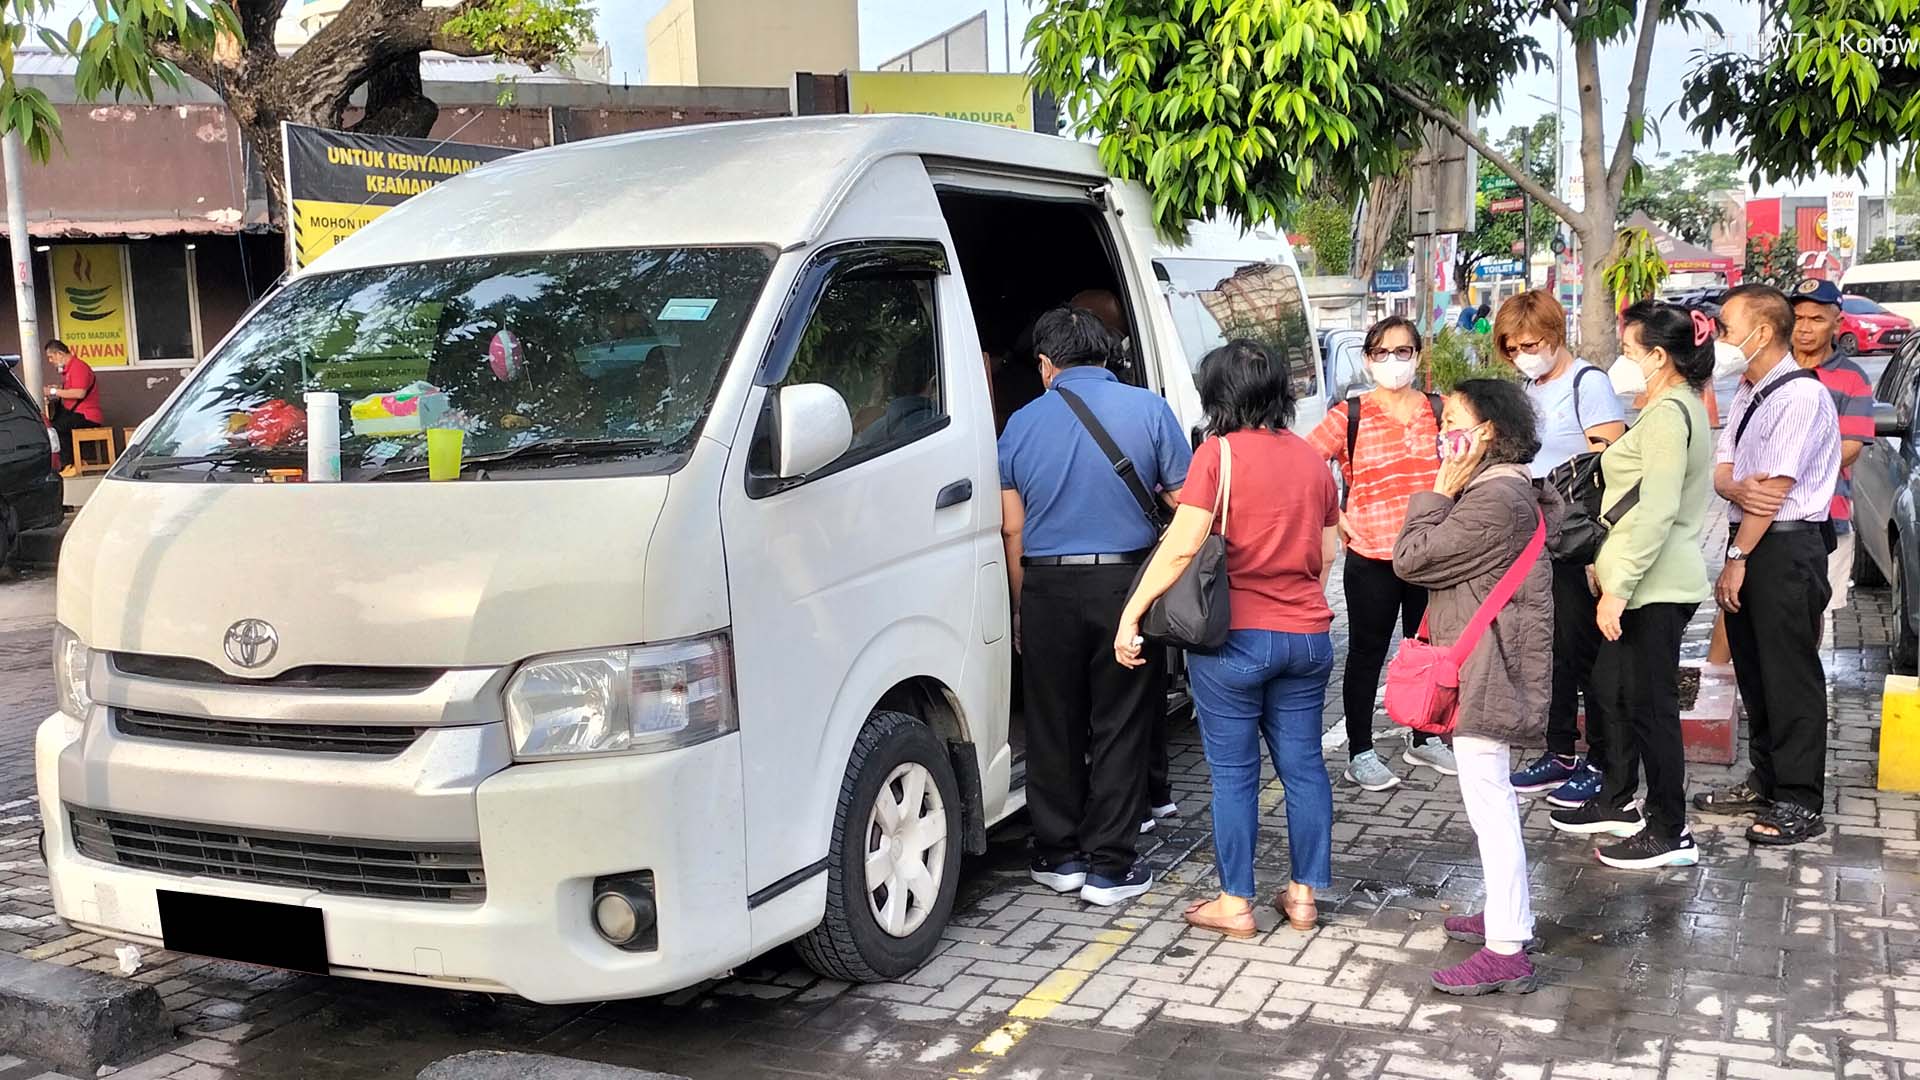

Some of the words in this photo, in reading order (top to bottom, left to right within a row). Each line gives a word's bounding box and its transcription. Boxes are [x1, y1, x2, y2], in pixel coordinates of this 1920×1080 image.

[944, 111, 1015, 123] MADURA
[327, 146, 385, 168] UNTUK
[388, 152, 488, 174] KENYAMAN
[366, 175, 440, 194] KEAMAN
[1832, 190, 1854, 199] NOW
[310, 216, 356, 229] MOHON
[1483, 264, 1514, 274] TOILET
[65, 332, 86, 340] SOTO
[87, 331, 121, 339] MADURA
[69, 343, 125, 358] WAWAN
